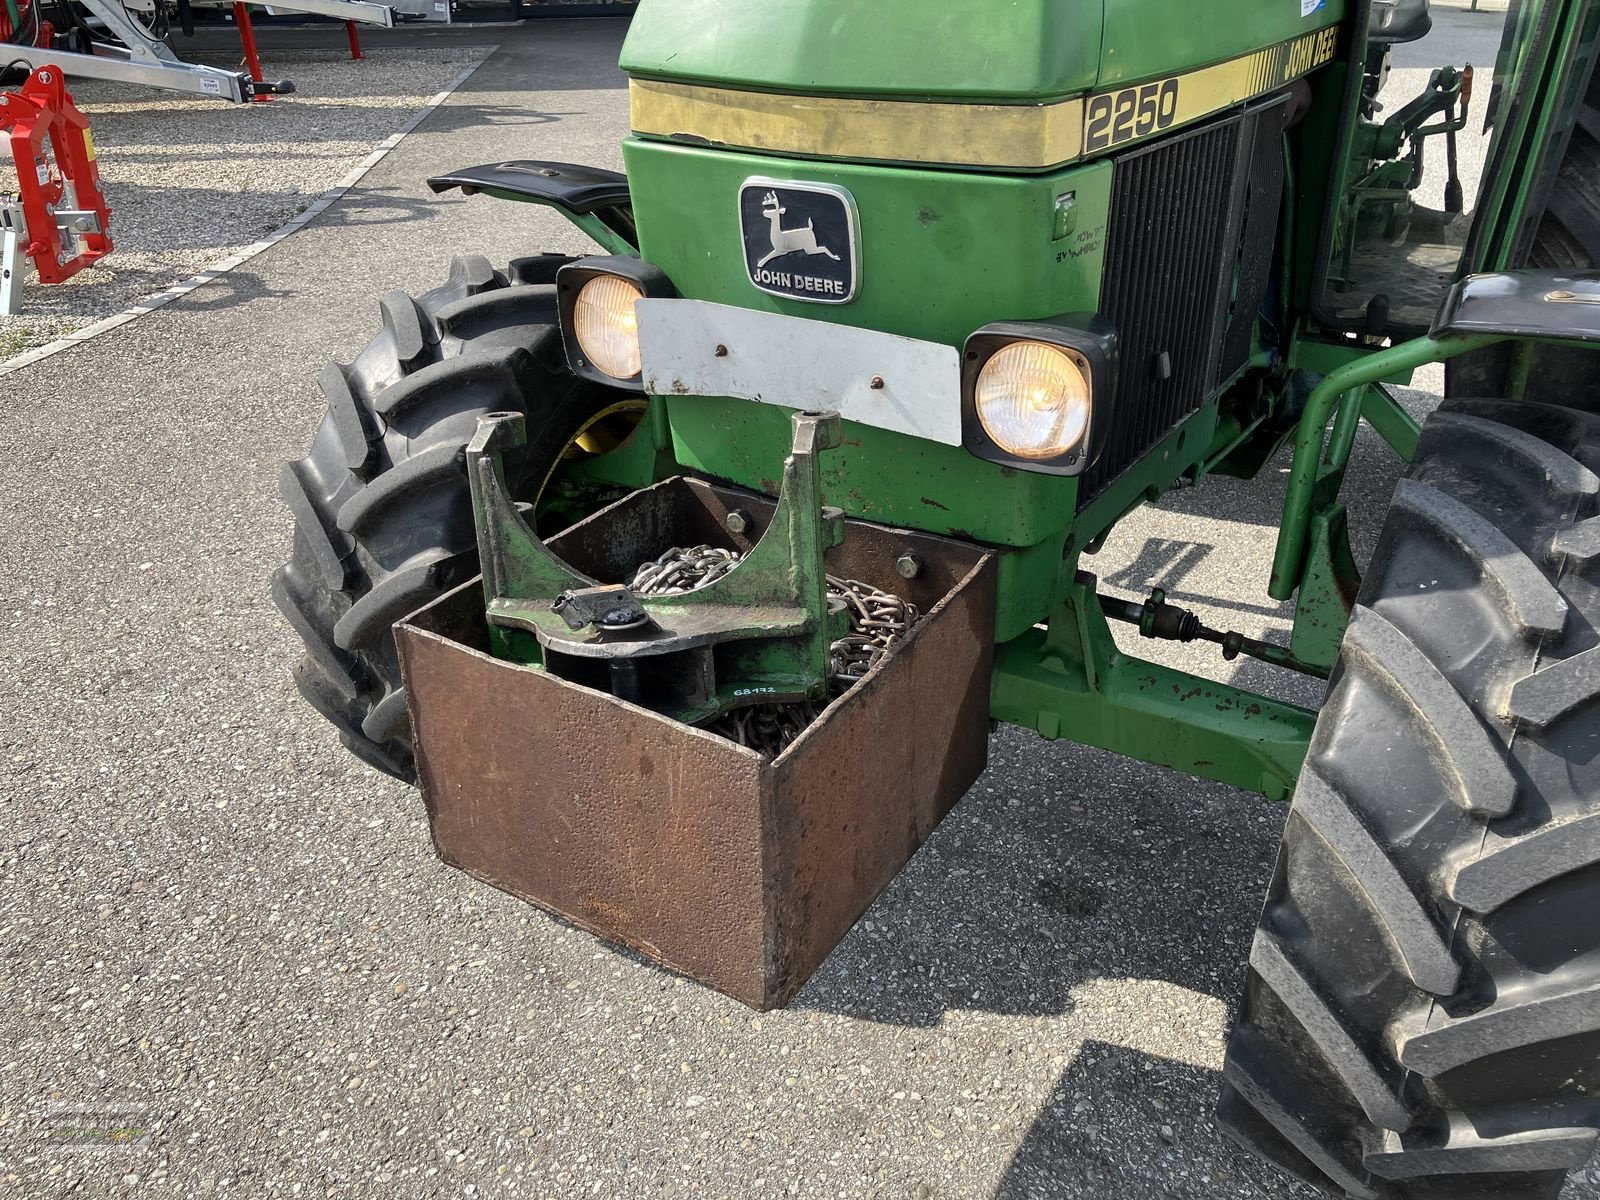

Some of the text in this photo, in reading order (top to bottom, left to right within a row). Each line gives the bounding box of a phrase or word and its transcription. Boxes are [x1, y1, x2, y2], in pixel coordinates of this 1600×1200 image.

[1284, 34, 1316, 80] JOHN
[1086, 78, 1179, 152] 2250
[753, 268, 845, 295] JOHN DEERE
[733, 686, 777, 697] 68172
